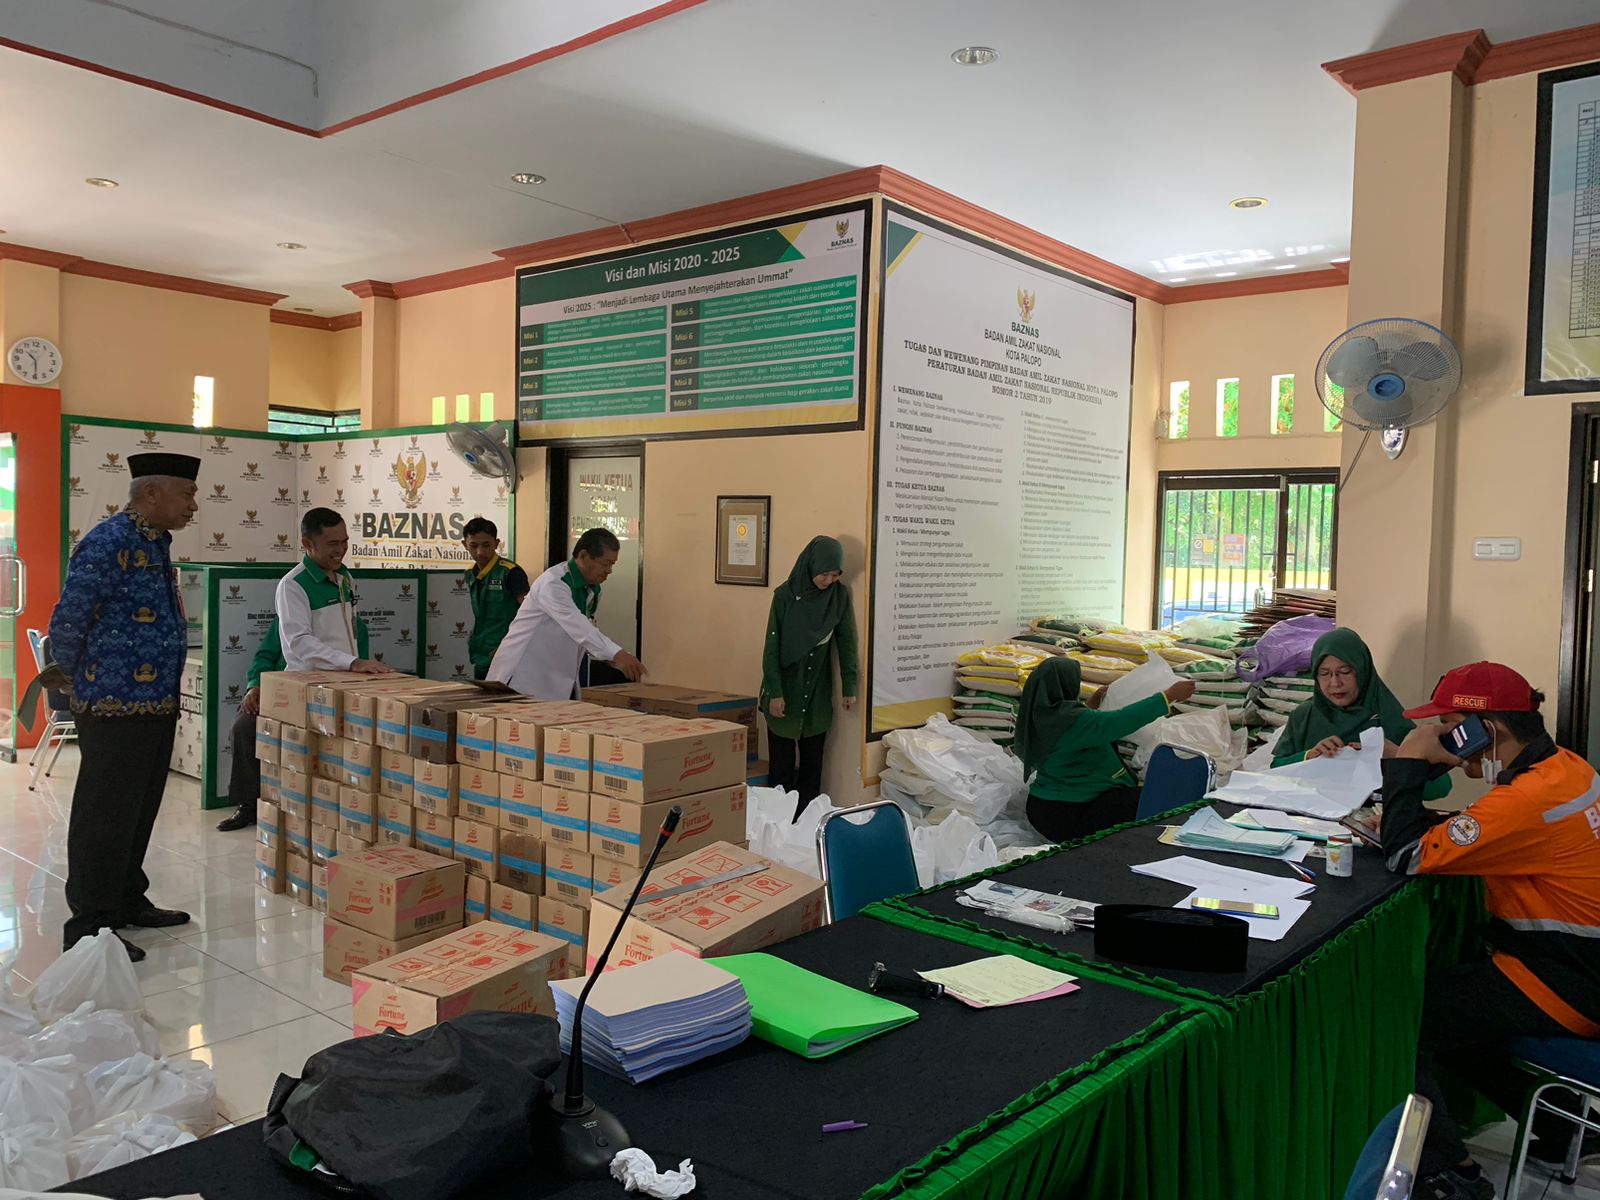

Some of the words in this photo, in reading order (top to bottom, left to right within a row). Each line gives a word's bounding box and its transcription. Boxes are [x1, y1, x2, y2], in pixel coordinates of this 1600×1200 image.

[605, 267, 623, 283] Visi
[625, 265, 646, 279] dan
[648, 259, 671, 276] Misi
[674, 254, 701, 271] 2020
[711, 246, 740, 265] 2025
[563, 305, 575, 314] Visi
[576, 302, 592, 312] 2025
[629, 292, 660, 304] Lembaga
[662, 288, 686, 299] Utama
[688, 276, 755, 294] Menyejahterakan
[1011, 322, 1039, 338] BAZNAS
[984, 329, 1004, 343] BADAN
[1005, 334, 1018, 347] AMIL
[1018, 338, 1036, 352] ZAKAT
[1036, 343, 1061, 358] NASIONAL
[1006, 349, 1020, 360] KOTA
[1021, 353, 1042, 367] PALOPO
[904, 339, 927, 353] TUGAS
[928, 346, 942, 356] DAN
[943, 349, 979, 366] WEWENANG
[980, 358, 1008, 372] PIMPINAN
[1009, 366, 1028, 378] BADAN
[1029, 371, 1042, 380] AMIL
[1044, 374, 1060, 385] ZAKAT
[1061, 378, 1085, 391] NASIONAL
[1086, 384, 1100, 394] KOTA
[1100, 388, 1119, 399] PALOPO
[927, 358, 966, 375] PERATURAN
[967, 367, 988, 380] BADAN
[989, 373, 1003, 384] AMIL
[1004, 376, 1023, 388] ZAKAT
[1024, 381, 1050, 394] NASIONAL
[1051, 387, 1076, 400] REPUBLIK
[1077, 392, 1102, 405] INDONESIA
[992, 385, 1013, 398] NOMOR
[1014, 390, 1019, 398] 2
[1020, 391, 1038, 402] TAHUN
[1038, 395, 1052, 405] 2019
[362, 512, 465, 540] BAZNAS
[352, 544, 378, 557] Badan
[382, 544, 402, 558] Amil
[404, 545, 432, 559] Zakat
[1455, 696, 1485, 707] RESCUE
[684, 752, 712, 768] Fortune
[682, 812, 711, 830] Fortune
[348, 890, 371, 904] Fortune
[344, 951, 370, 965] Fortune
[379, 1006, 405, 1020] Fortune
